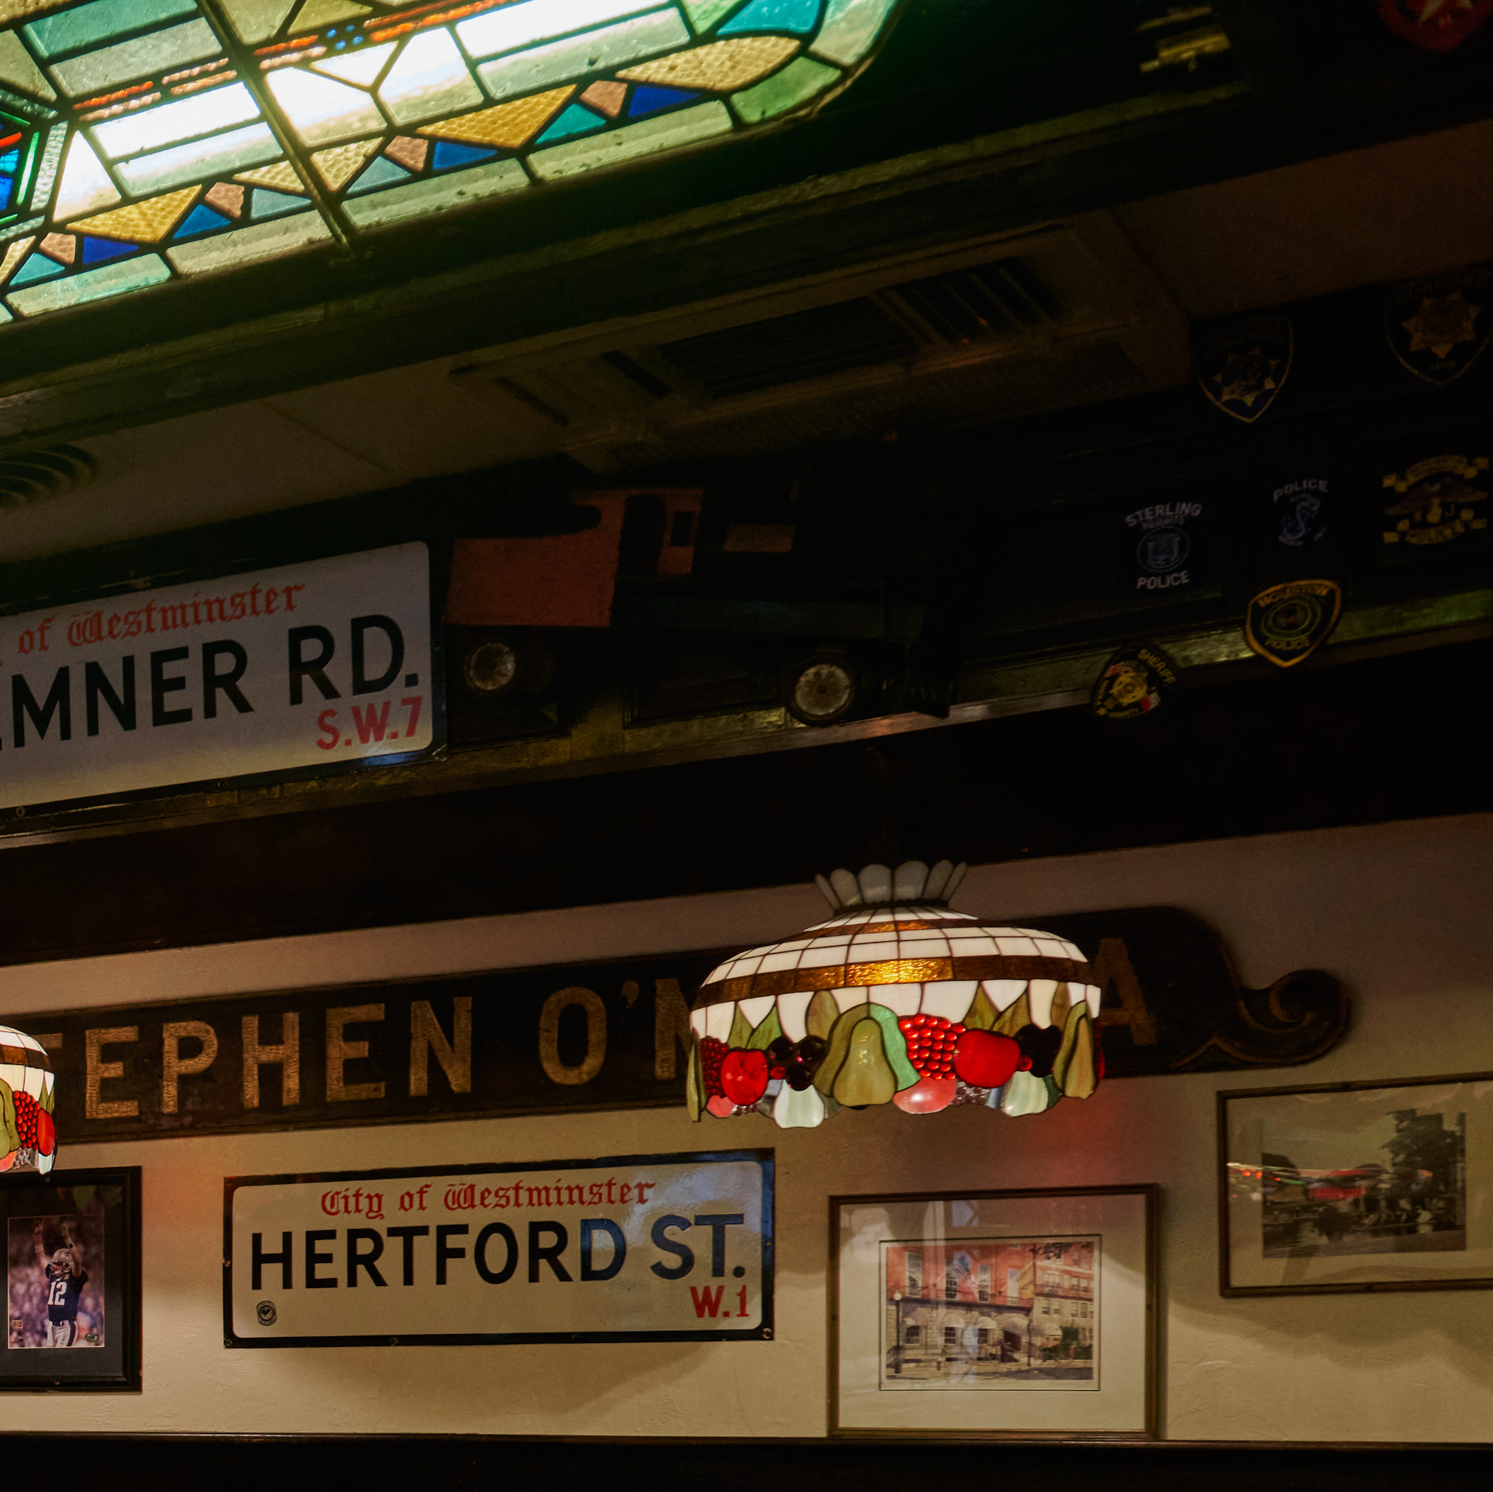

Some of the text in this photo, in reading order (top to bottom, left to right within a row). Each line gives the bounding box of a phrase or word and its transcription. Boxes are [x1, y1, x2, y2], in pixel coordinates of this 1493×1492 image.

[1273, 478, 1329, 503] POLICE
[1125, 502, 1203, 527] STERLING
[1142, 515, 1185, 530] HEIGHTS
[1136, 570, 1190, 590] POLICE
[17, 616, 56, 655] of
[66, 580, 306, 648] Westminster
[287, 614, 420, 705] RD.
[1137, 648, 1177, 684] SHERIFF
[316, 696, 424, 750] S.W.7
[32, 995, 474, 1120] EPHEN
[321, 1177, 657, 1220] City of Westminster
[251, 1212, 746, 1291] HERTFORD ST.
[47, 1281, 67, 1306] 12
[689, 1284, 752, 1320] W.1
